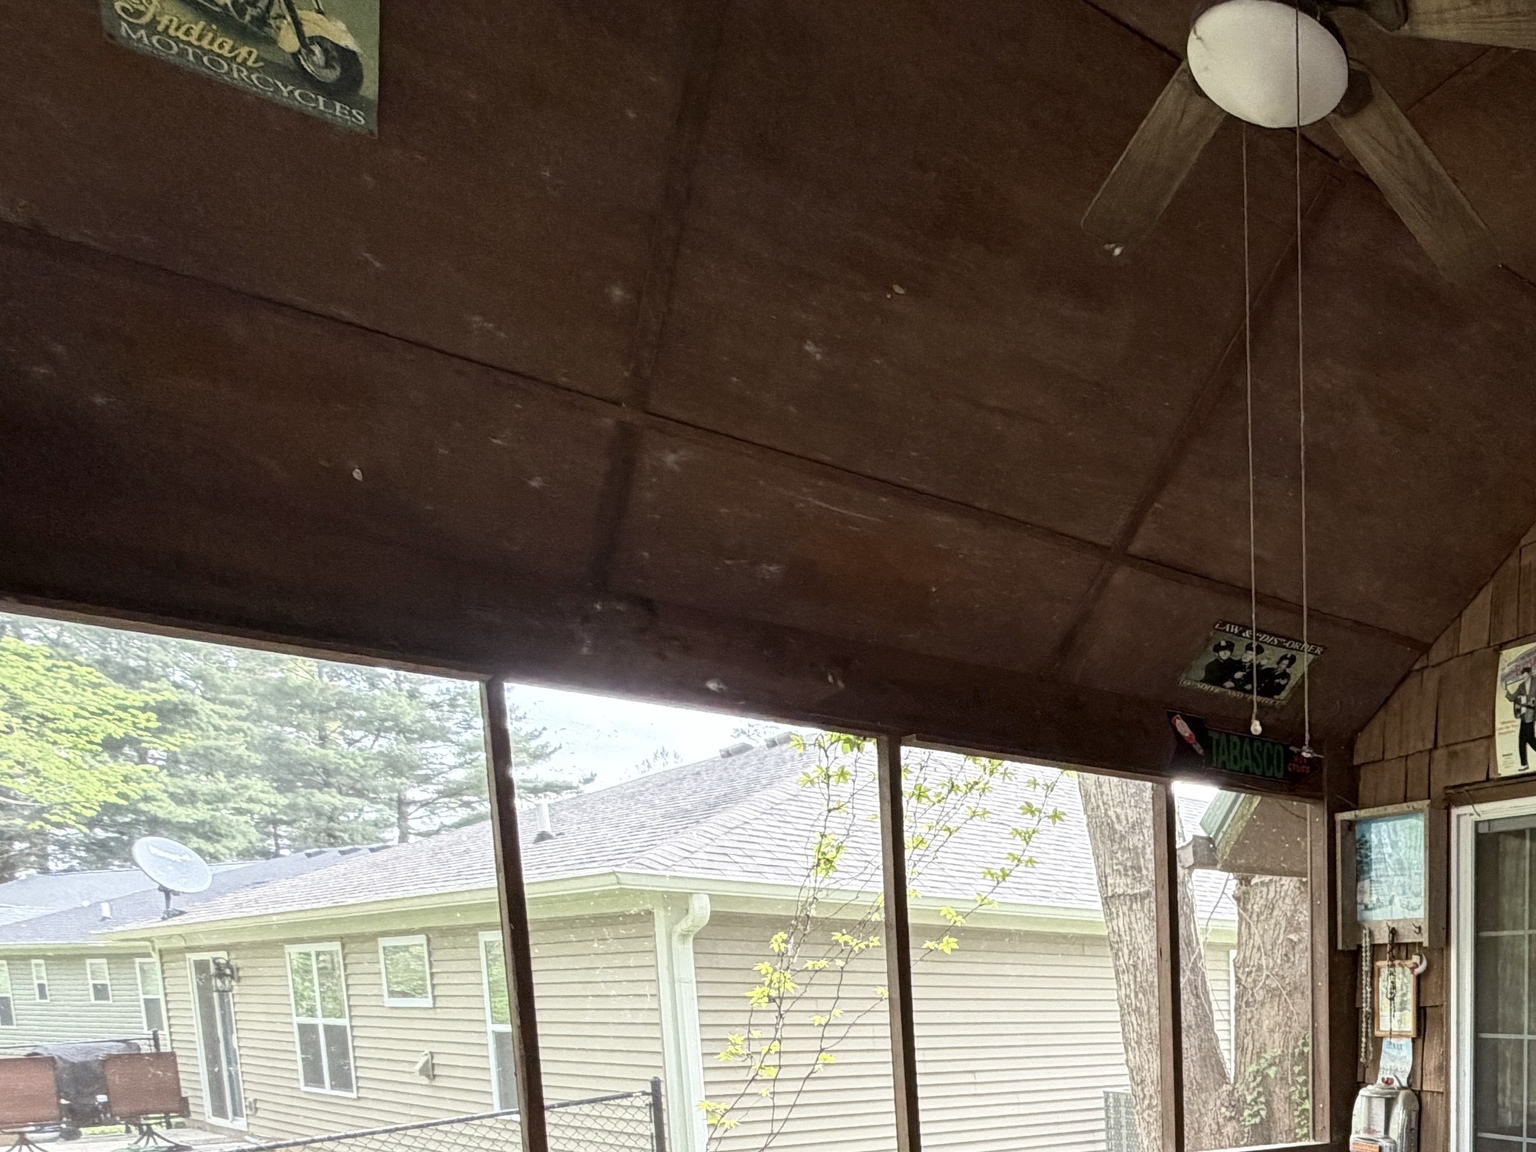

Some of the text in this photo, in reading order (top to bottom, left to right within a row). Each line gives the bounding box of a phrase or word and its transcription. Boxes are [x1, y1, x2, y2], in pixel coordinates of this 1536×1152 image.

[119, 21, 367, 126] MOTORCYCLES
[1214, 622, 1243, 636] LAW
[1208, 733, 1285, 778] TABASCO
